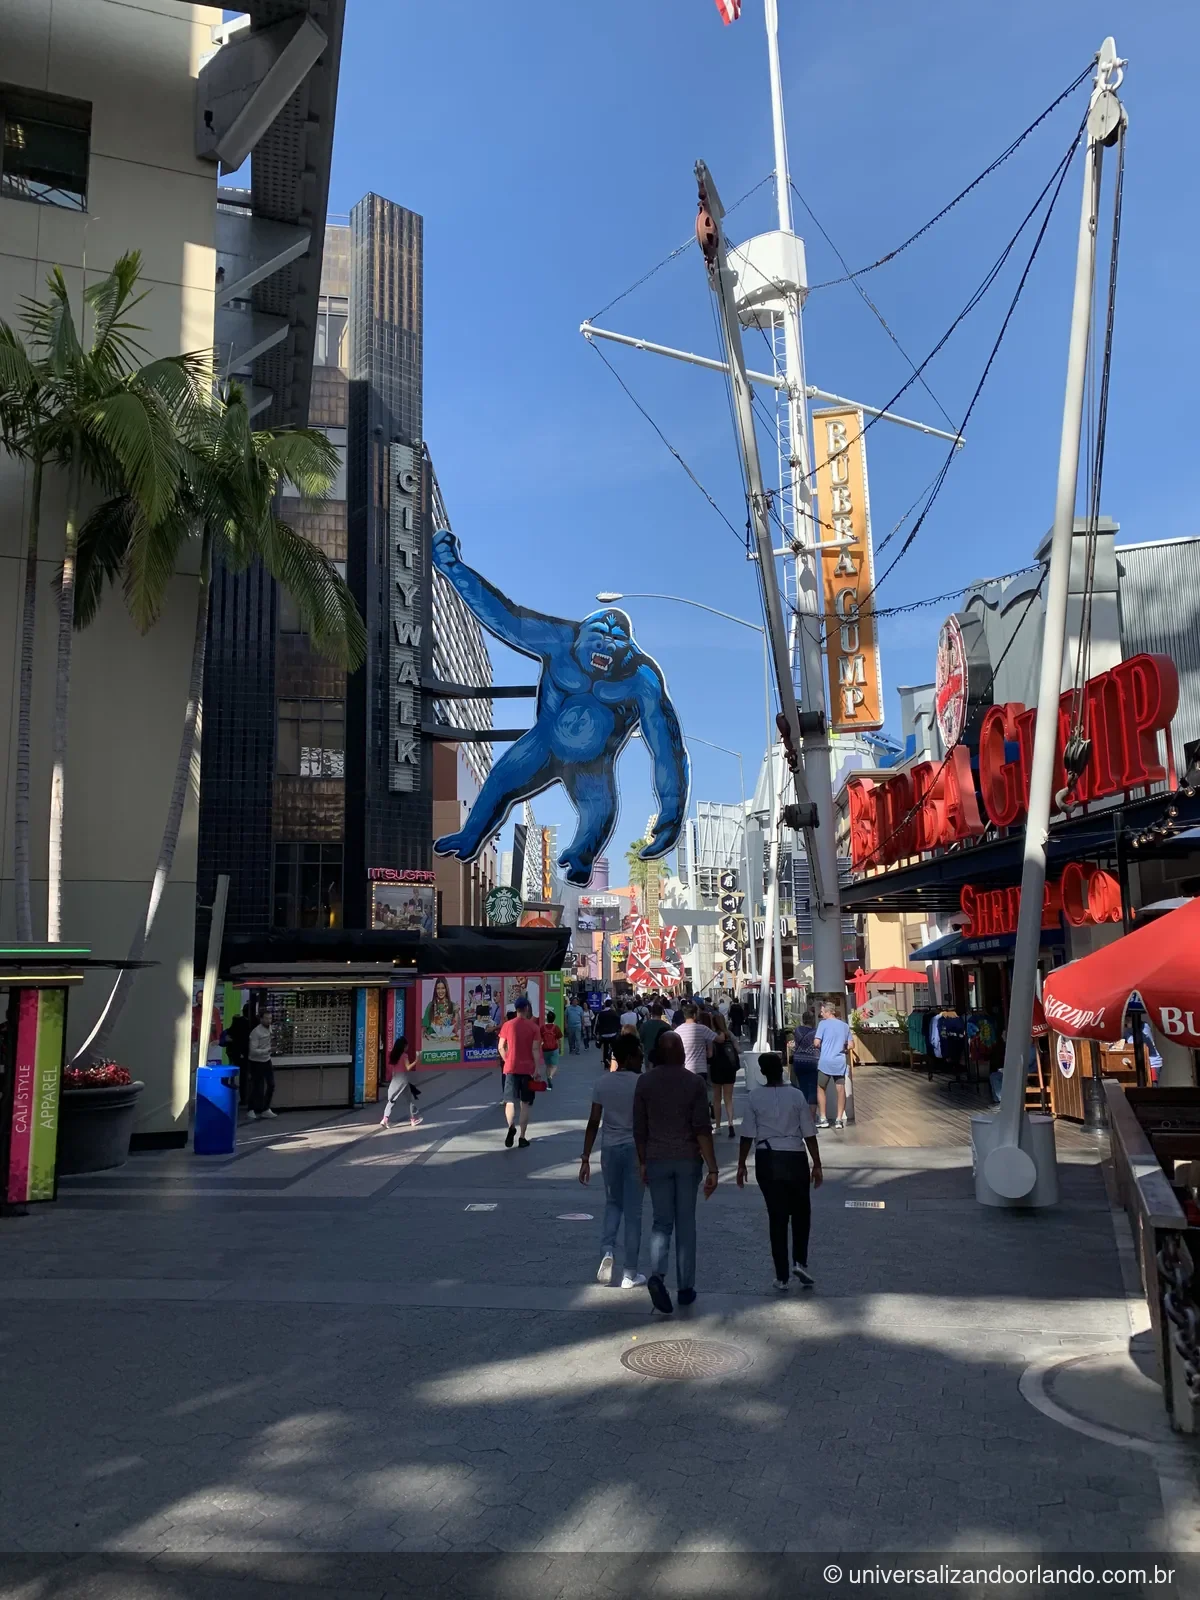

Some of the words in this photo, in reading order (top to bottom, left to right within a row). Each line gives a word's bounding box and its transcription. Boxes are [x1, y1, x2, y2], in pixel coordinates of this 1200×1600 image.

[825, 419, 858, 577] BUBBA
[393, 468, 423, 765] CITYWALK
[834, 587, 866, 718] GUMP
[847, 745, 984, 872] BUBBA
[543, 829, 553, 899] CITYW
[15, 1105, 28, 1133] CALI
[17, 1064, 31, 1100] STYLE
[40, 1065, 58, 1130] APPAREL
